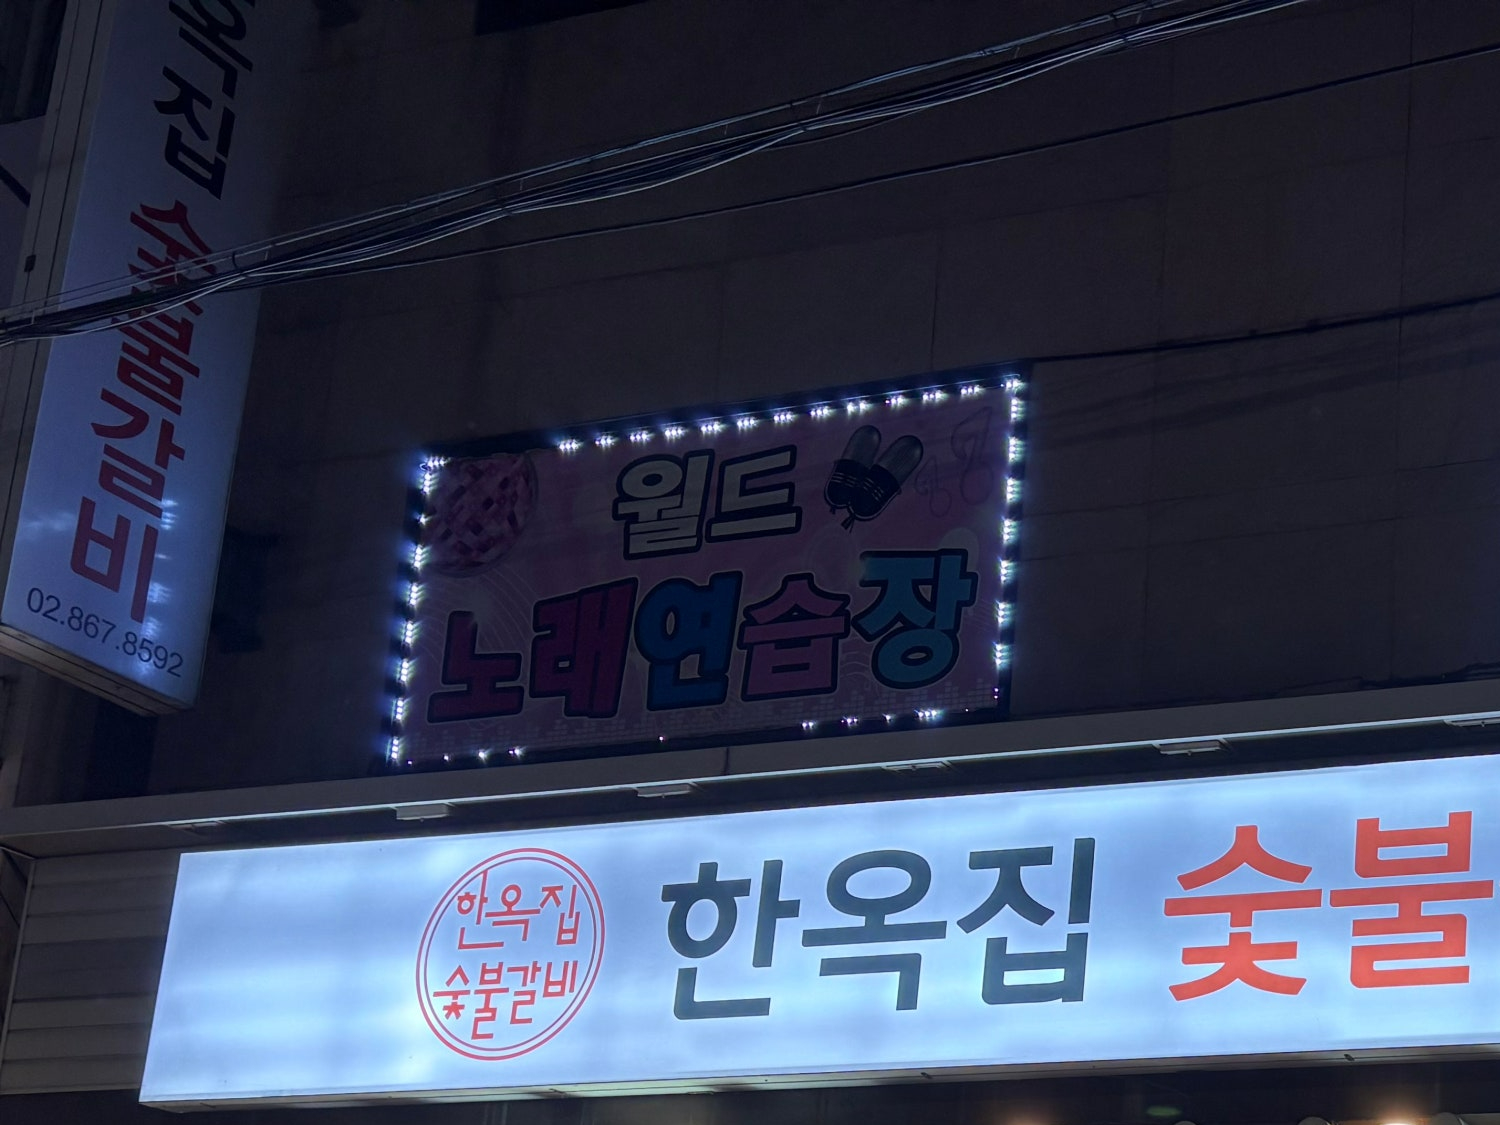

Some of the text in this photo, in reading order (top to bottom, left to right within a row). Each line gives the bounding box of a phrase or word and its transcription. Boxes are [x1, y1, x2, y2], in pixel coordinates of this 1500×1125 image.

[153, 0, 255, 200] 옥집
[612, 445, 802, 559] 월드
[26, 587, 184, 677] 02.867.8592
[427, 549, 978, 723] 노래연습장
[455, 871, 581, 950] 한옥집
[661, 837, 1095, 1019] 한옥집
[432, 960, 577, 1040] 숯불갈비
